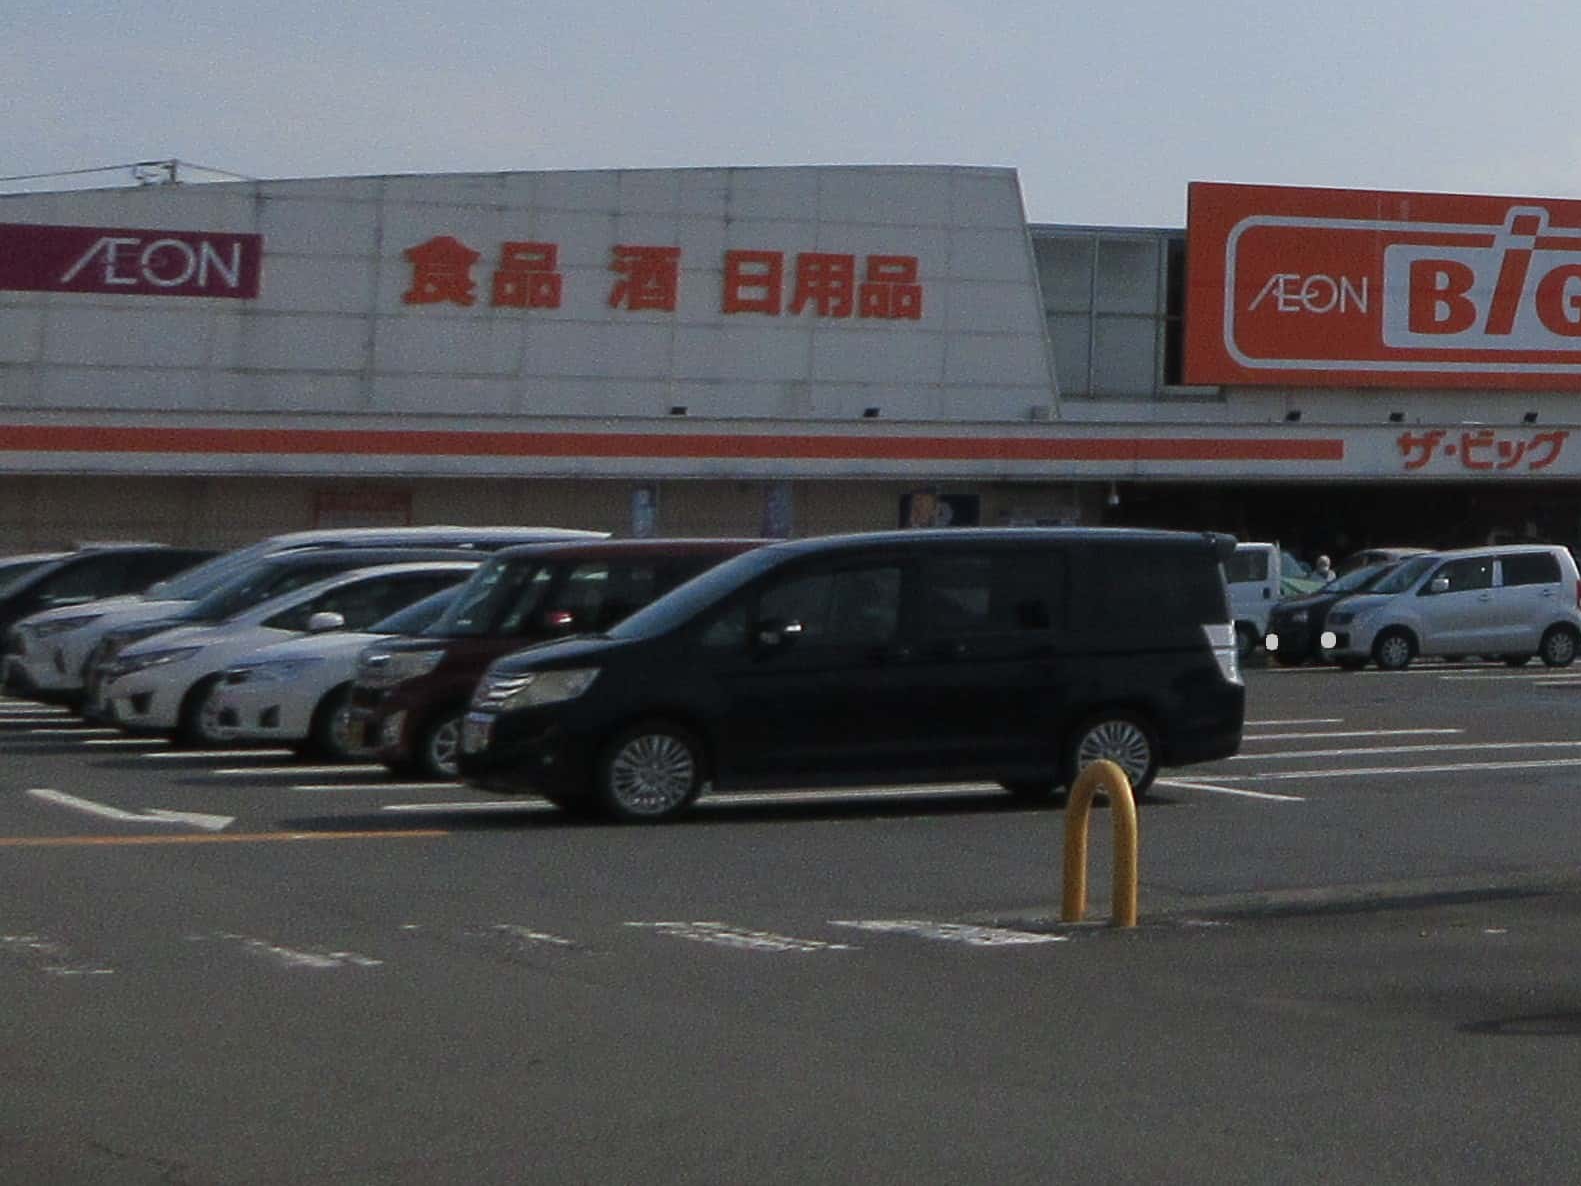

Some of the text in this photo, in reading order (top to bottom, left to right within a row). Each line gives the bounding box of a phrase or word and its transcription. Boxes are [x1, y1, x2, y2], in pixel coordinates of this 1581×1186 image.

[404, 235, 923, 320] 食品 酒 日用品
